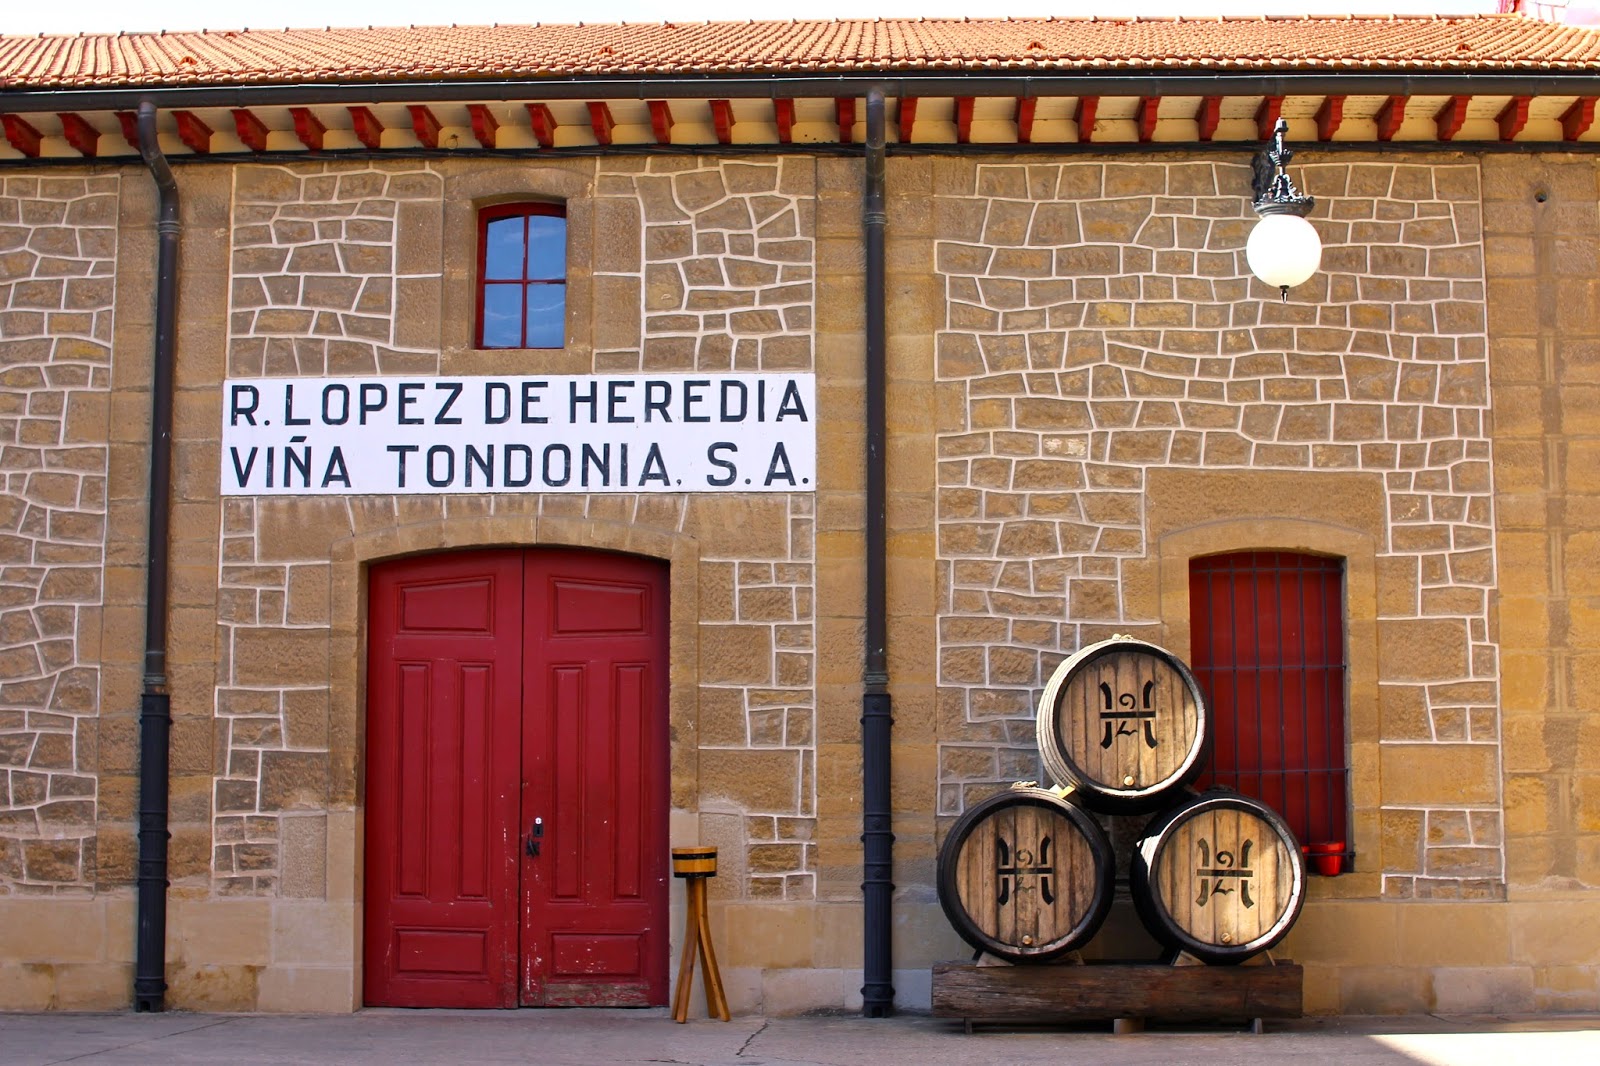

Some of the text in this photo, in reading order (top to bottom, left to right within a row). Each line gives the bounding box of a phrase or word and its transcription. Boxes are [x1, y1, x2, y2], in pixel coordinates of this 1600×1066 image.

[484, 381, 549, 425] DE
[569, 379, 809, 425] HEREDIA
[229, 435, 352, 488] VIÑA
